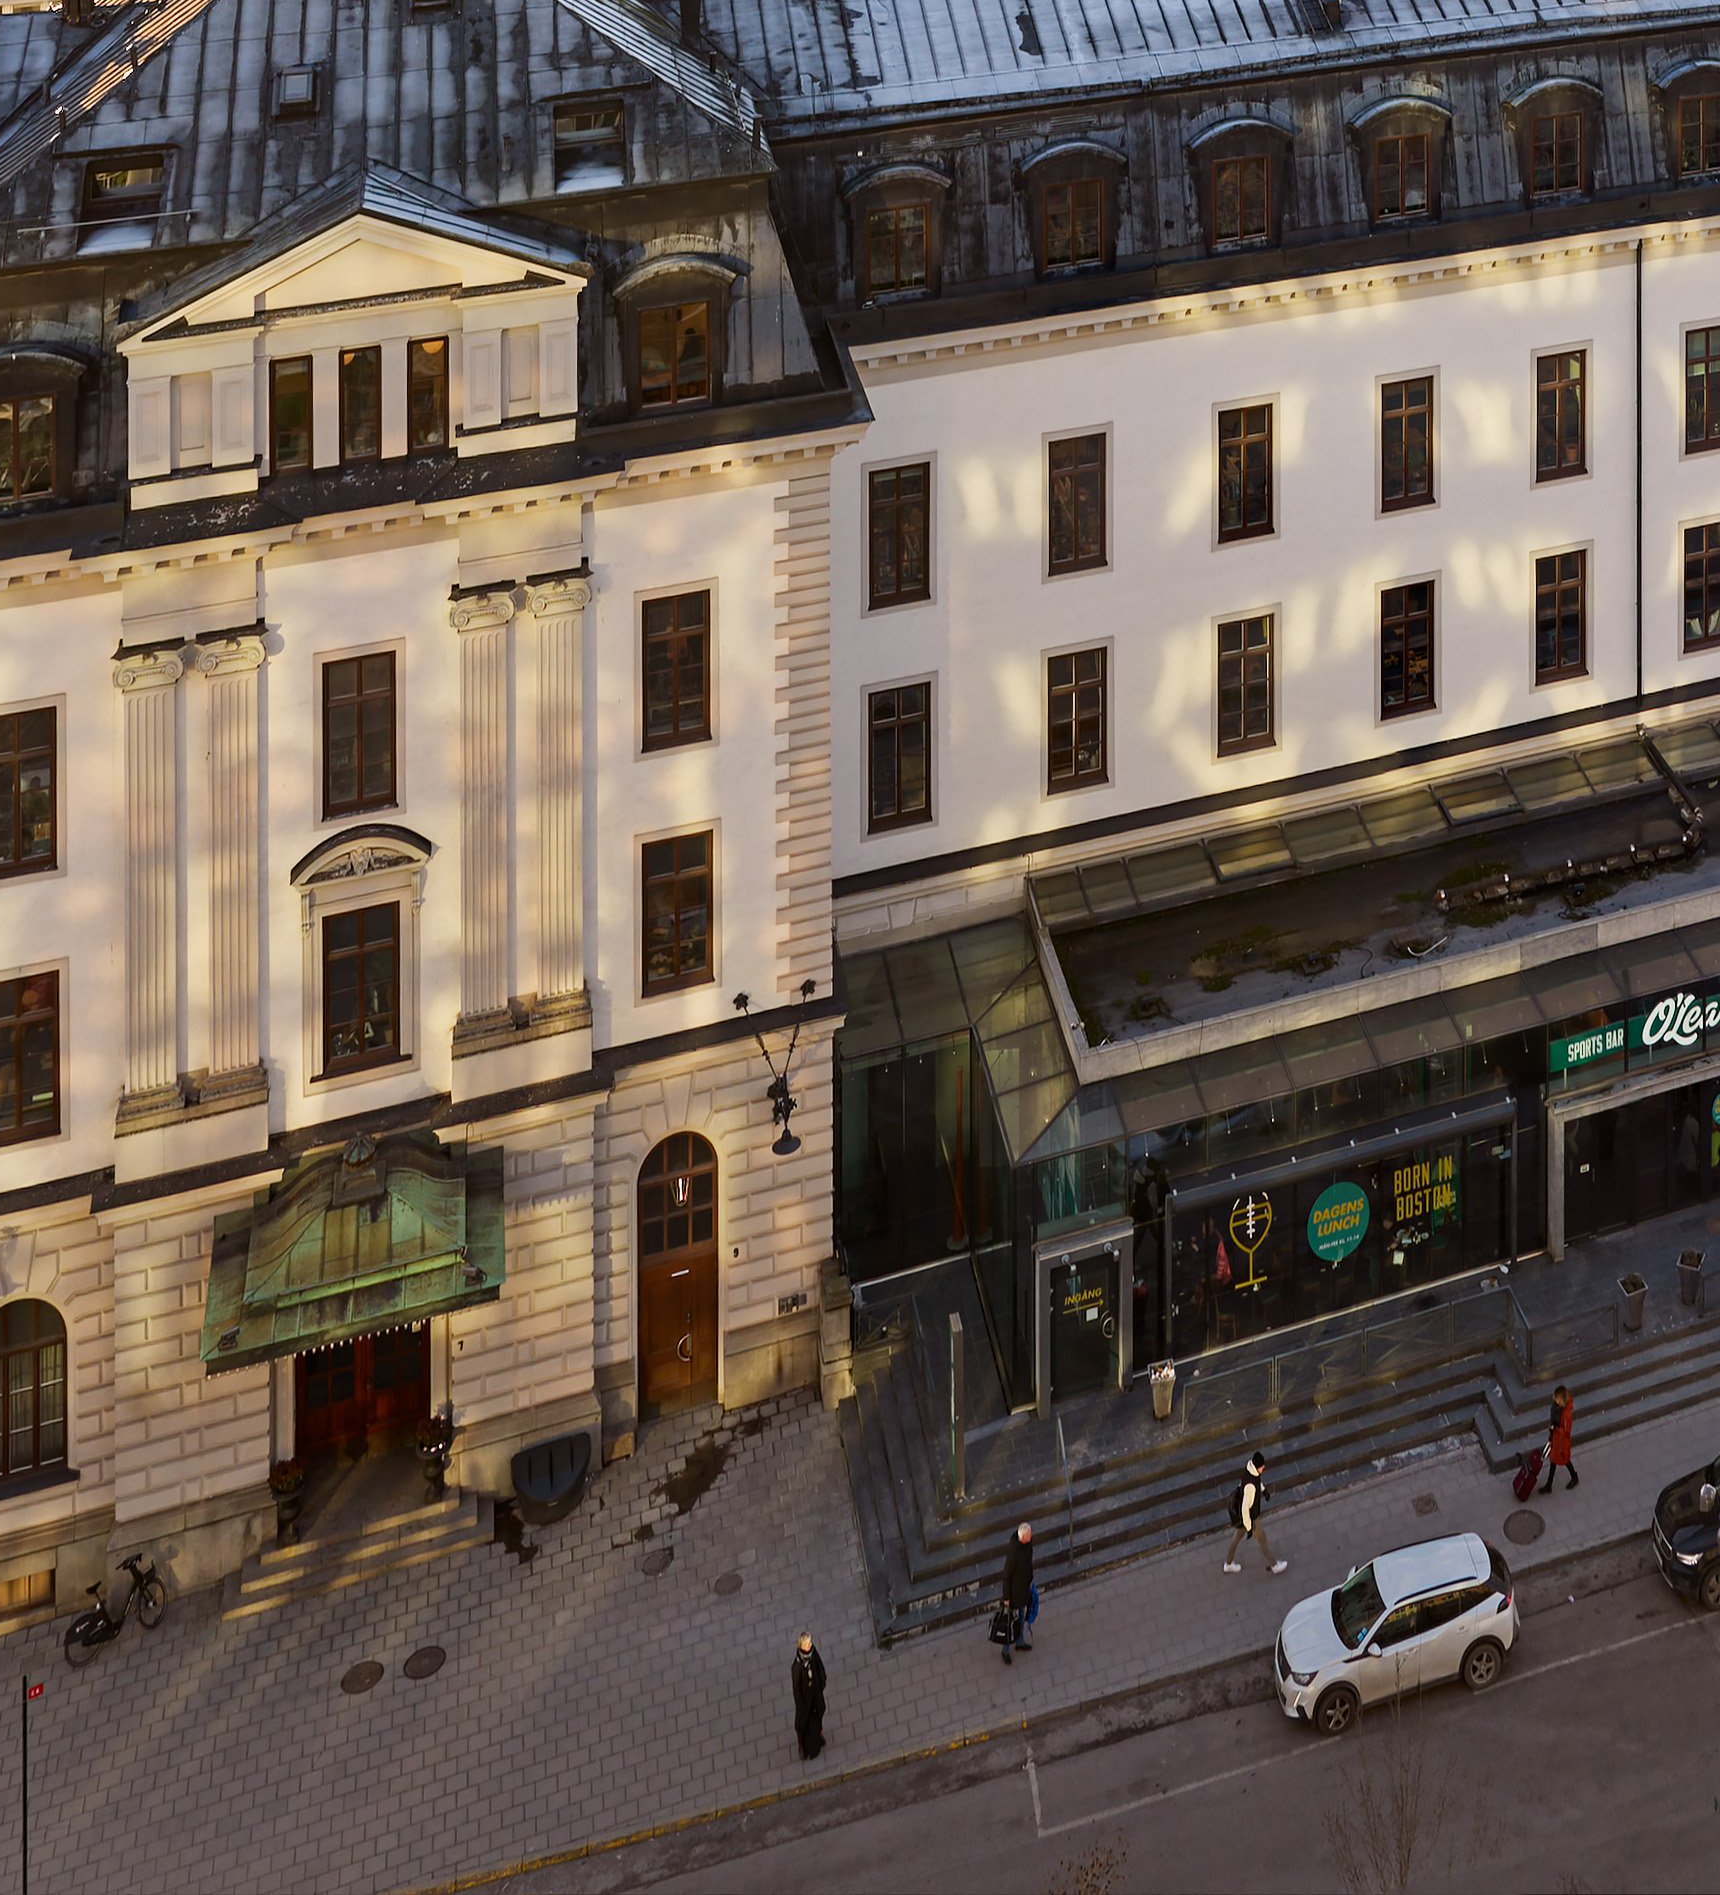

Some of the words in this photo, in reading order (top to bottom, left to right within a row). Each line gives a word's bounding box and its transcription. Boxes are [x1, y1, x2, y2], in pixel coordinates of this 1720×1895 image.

[1567, 1033, 1603, 1062] SPORTS
[1605, 1028, 1624, 1050] BAR
[1393, 1162, 1431, 1195] BORN
[1438, 1155, 1453, 1182] IN
[1313, 1198, 1365, 1225] DAGENS
[1396, 1183, 1451, 1222] BOSTON
[1317, 1214, 1360, 1237] LUNCH
[733, 1247, 739, 1258] 9
